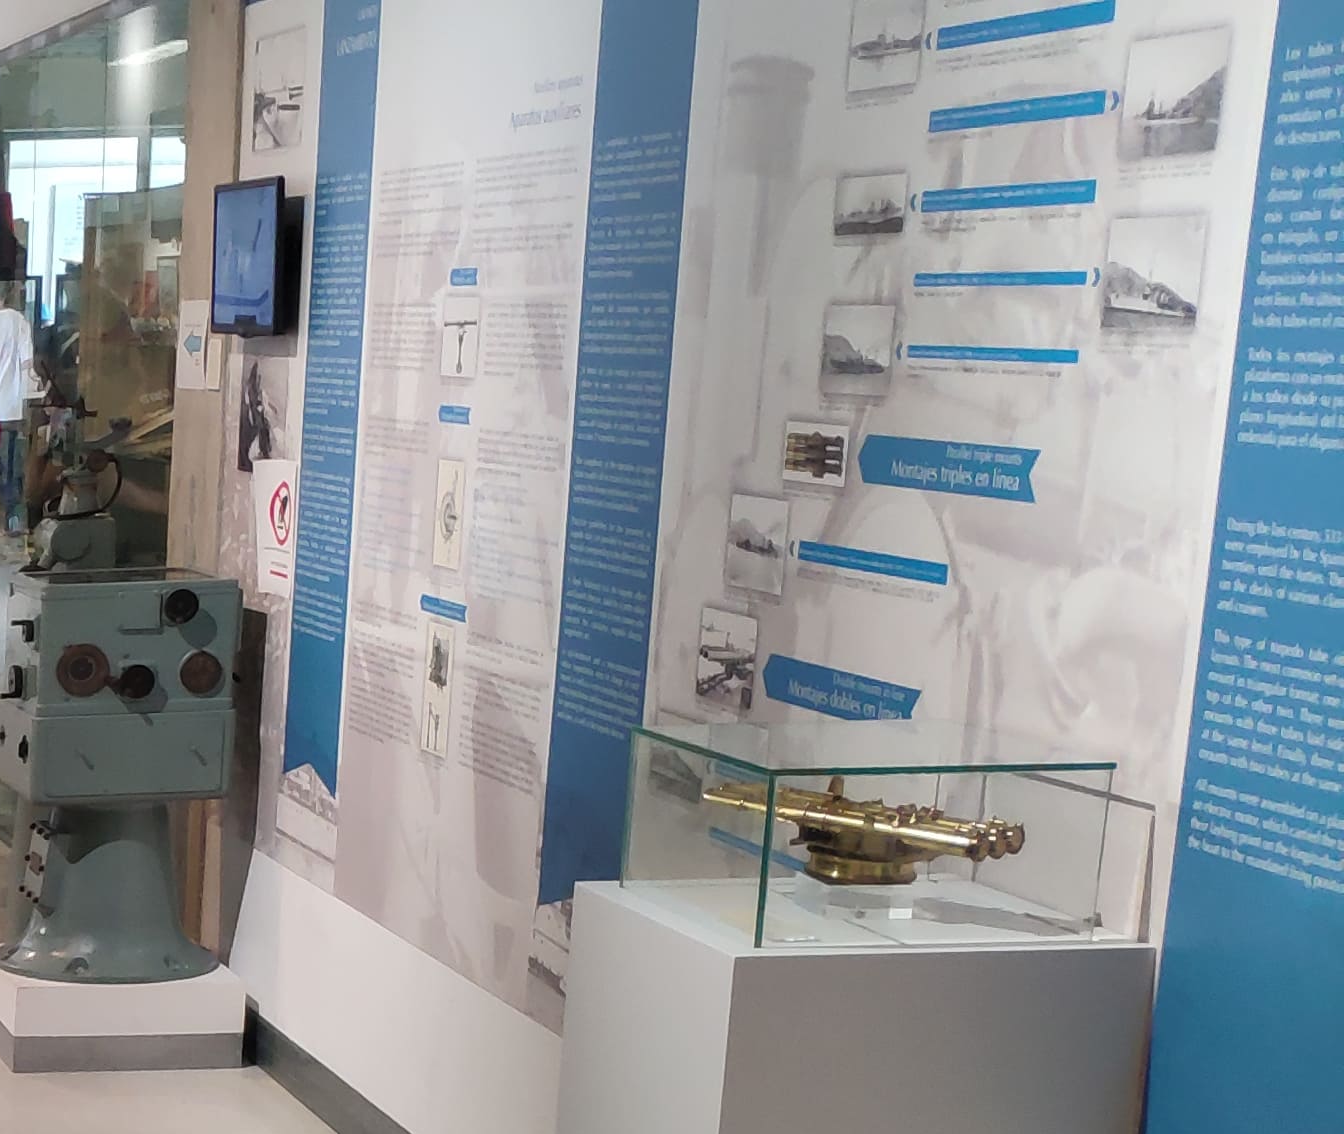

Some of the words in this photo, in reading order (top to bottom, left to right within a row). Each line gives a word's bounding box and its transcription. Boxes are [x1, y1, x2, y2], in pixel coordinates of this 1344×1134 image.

[890, 458, 938, 486] Montajes
[940, 462, 973, 489] triples
[974, 474, 989, 487] en
[992, 464, 1020, 491] línea
[788, 677, 829, 707] Montajes
[830, 689, 861, 713] dobles
